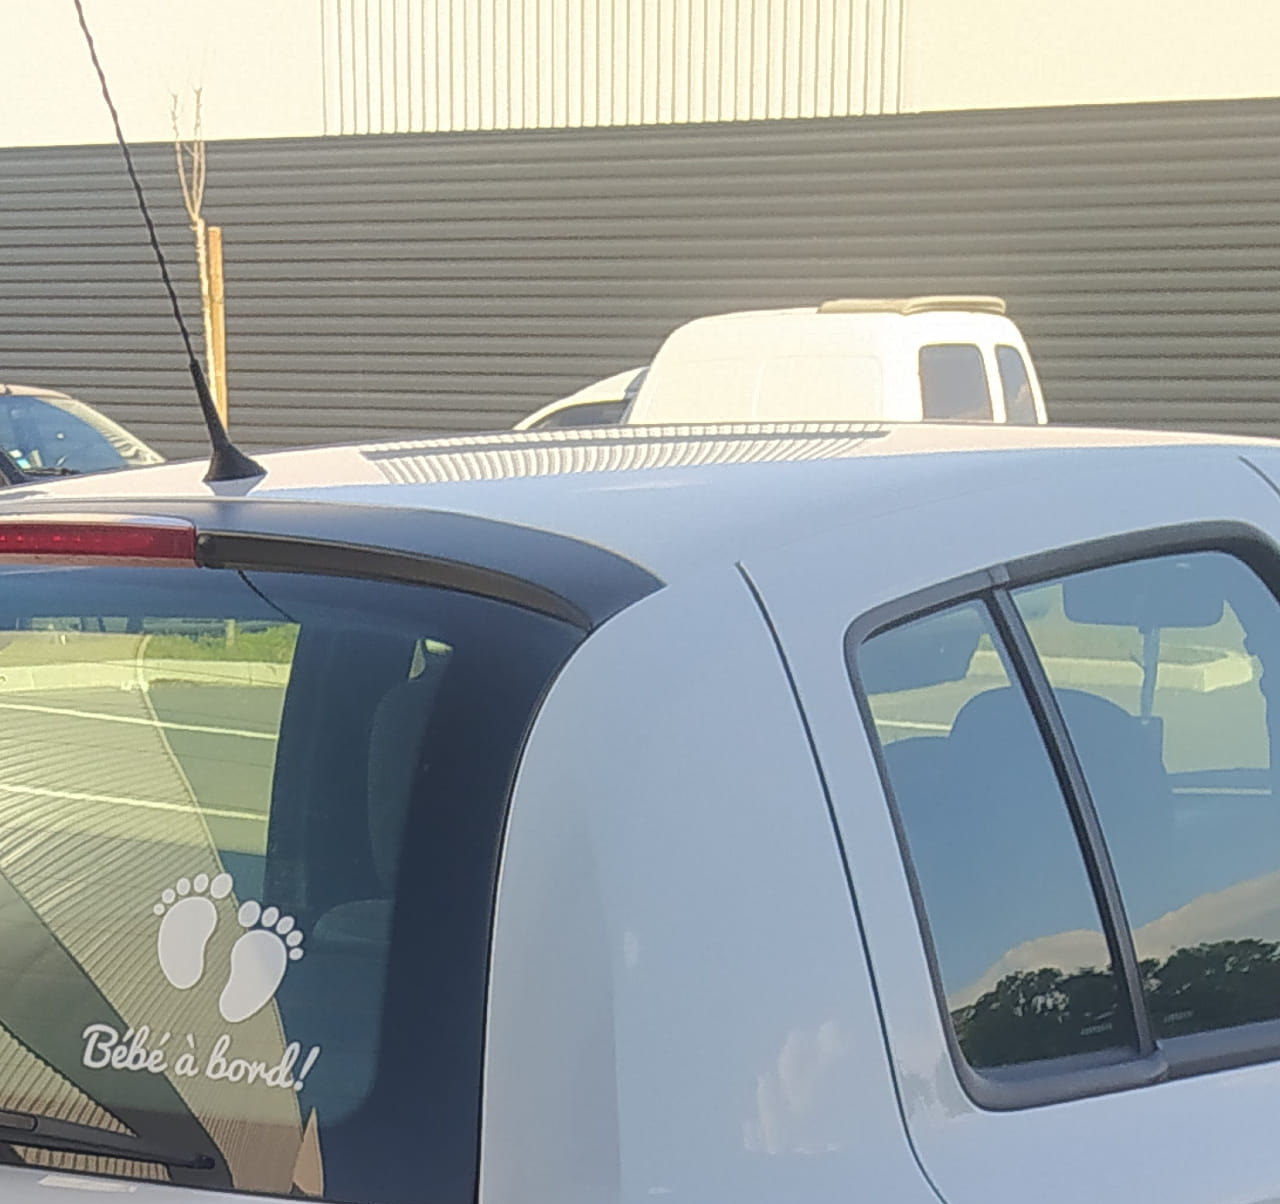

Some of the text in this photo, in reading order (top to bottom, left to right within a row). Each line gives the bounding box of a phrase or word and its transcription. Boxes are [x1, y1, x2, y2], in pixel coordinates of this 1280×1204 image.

[82, 1023, 320, 1091] Bébé à bord!
